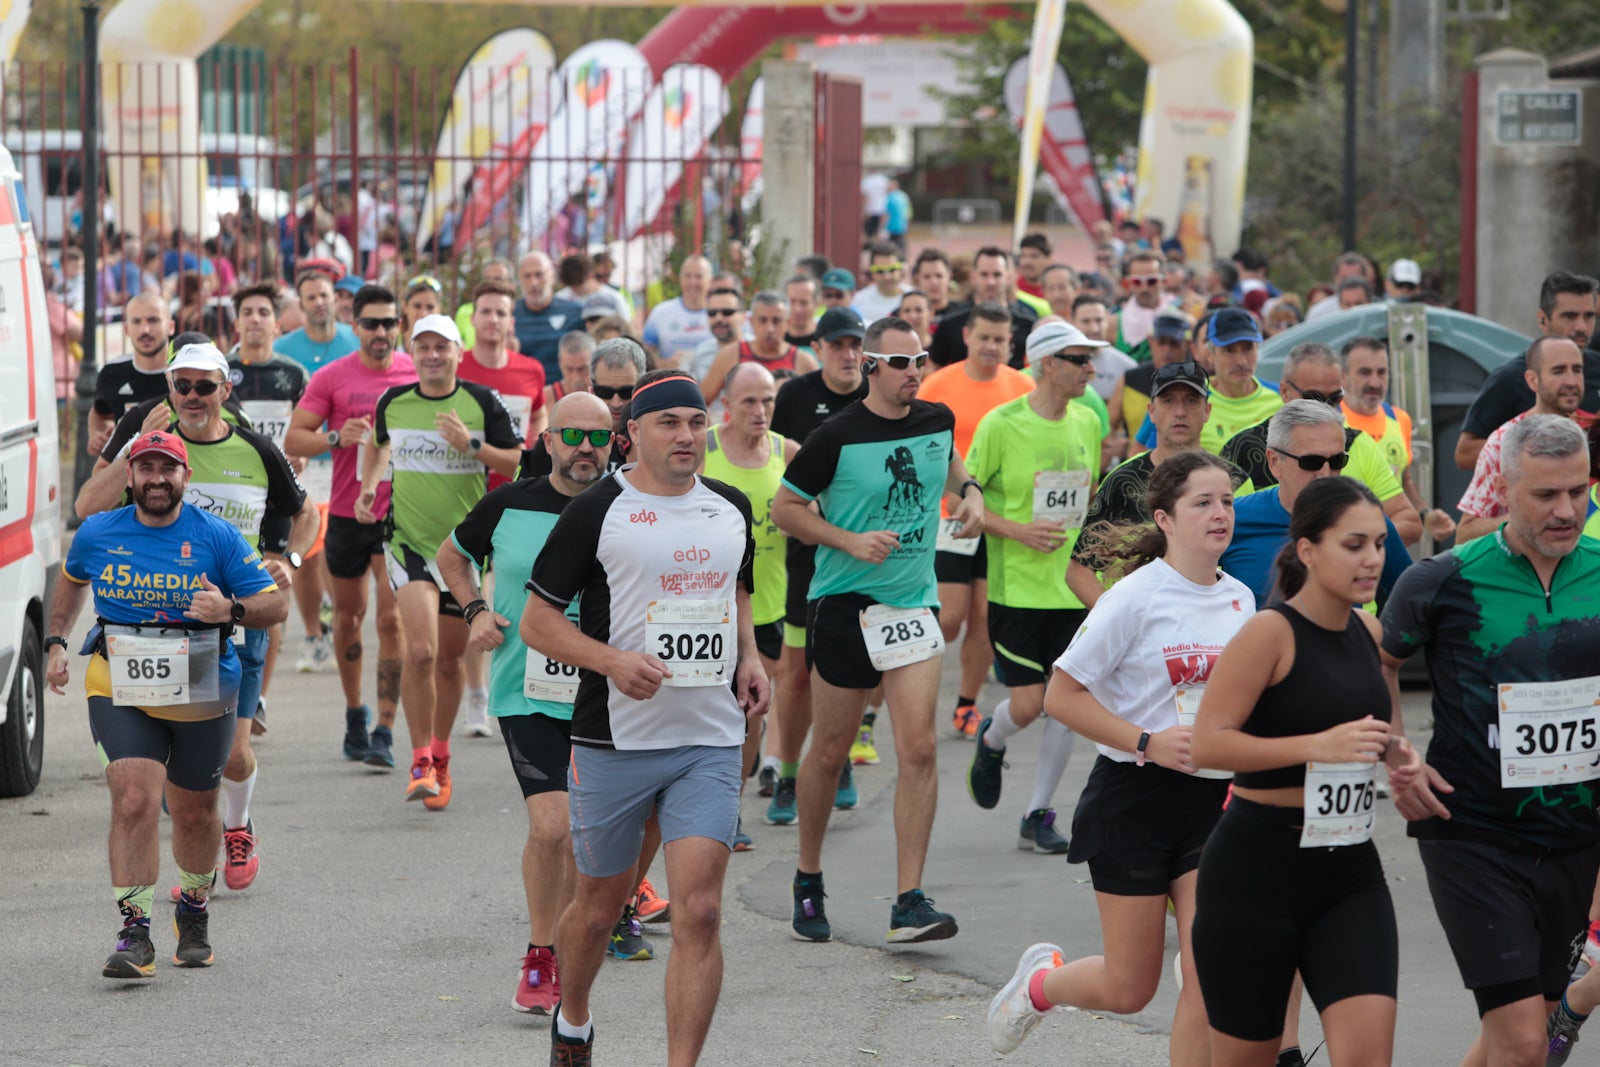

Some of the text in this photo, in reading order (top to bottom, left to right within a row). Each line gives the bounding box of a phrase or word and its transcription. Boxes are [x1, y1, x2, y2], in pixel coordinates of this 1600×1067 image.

[1524, 95, 1570, 109] CALLE
[1046, 490, 1077, 508] 641
[630, 509, 658, 526] edp
[673, 545, 711, 565] edp
[101, 563, 204, 590] 45 MEDIA
[98, 587, 167, 602] MARATON
[881, 619, 925, 646] 283
[657, 633, 723, 660] 3020
[1163, 643, 1191, 654] Media
[127, 657, 171, 680] 865
[1515, 718, 1597, 755] 3075
[1317, 779, 1374, 815] 3076
